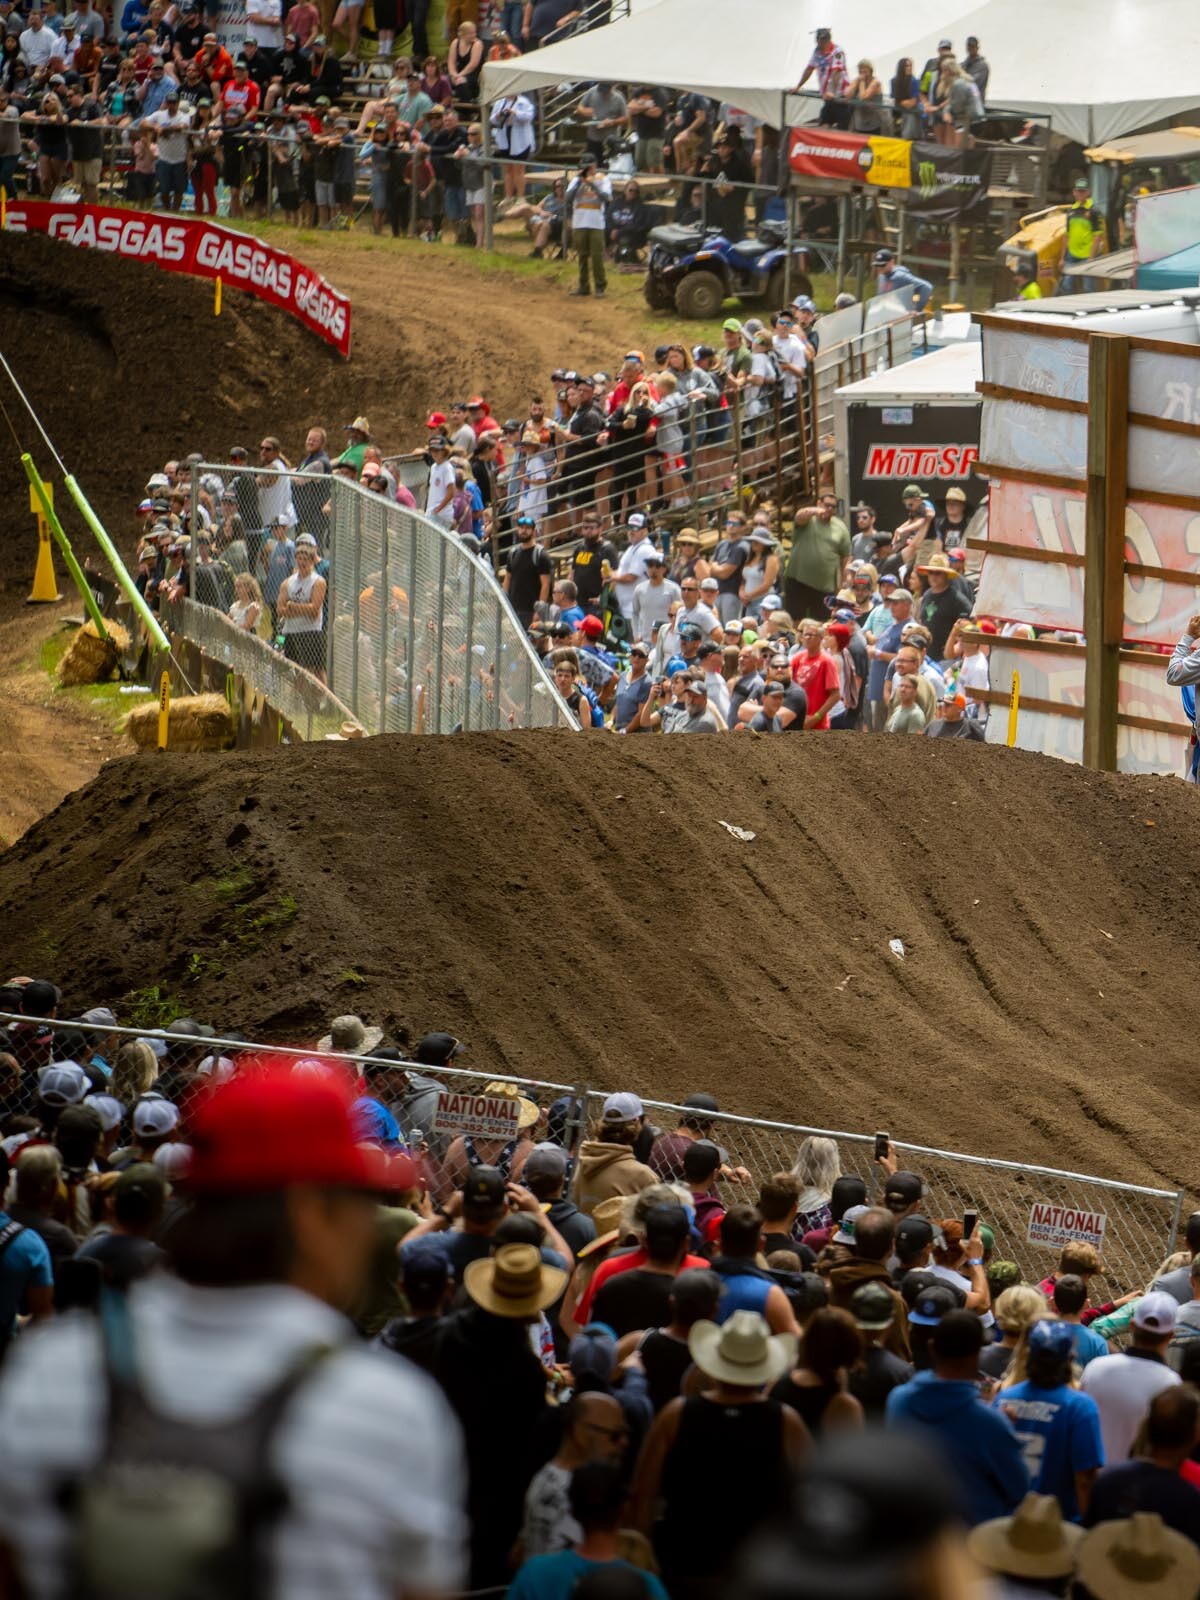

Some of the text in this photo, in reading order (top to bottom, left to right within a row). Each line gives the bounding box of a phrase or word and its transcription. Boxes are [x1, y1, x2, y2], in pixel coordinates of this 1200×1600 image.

[48, 213, 186, 260] GASGAS
[197, 233, 291, 298] GASGAS
[295, 274, 345, 340] GASGAS
[863, 443, 979, 480] MOTOSP
[437, 1093, 519, 1121] NATIONAL
[1032, 1204, 1102, 1235] NATIONAL
